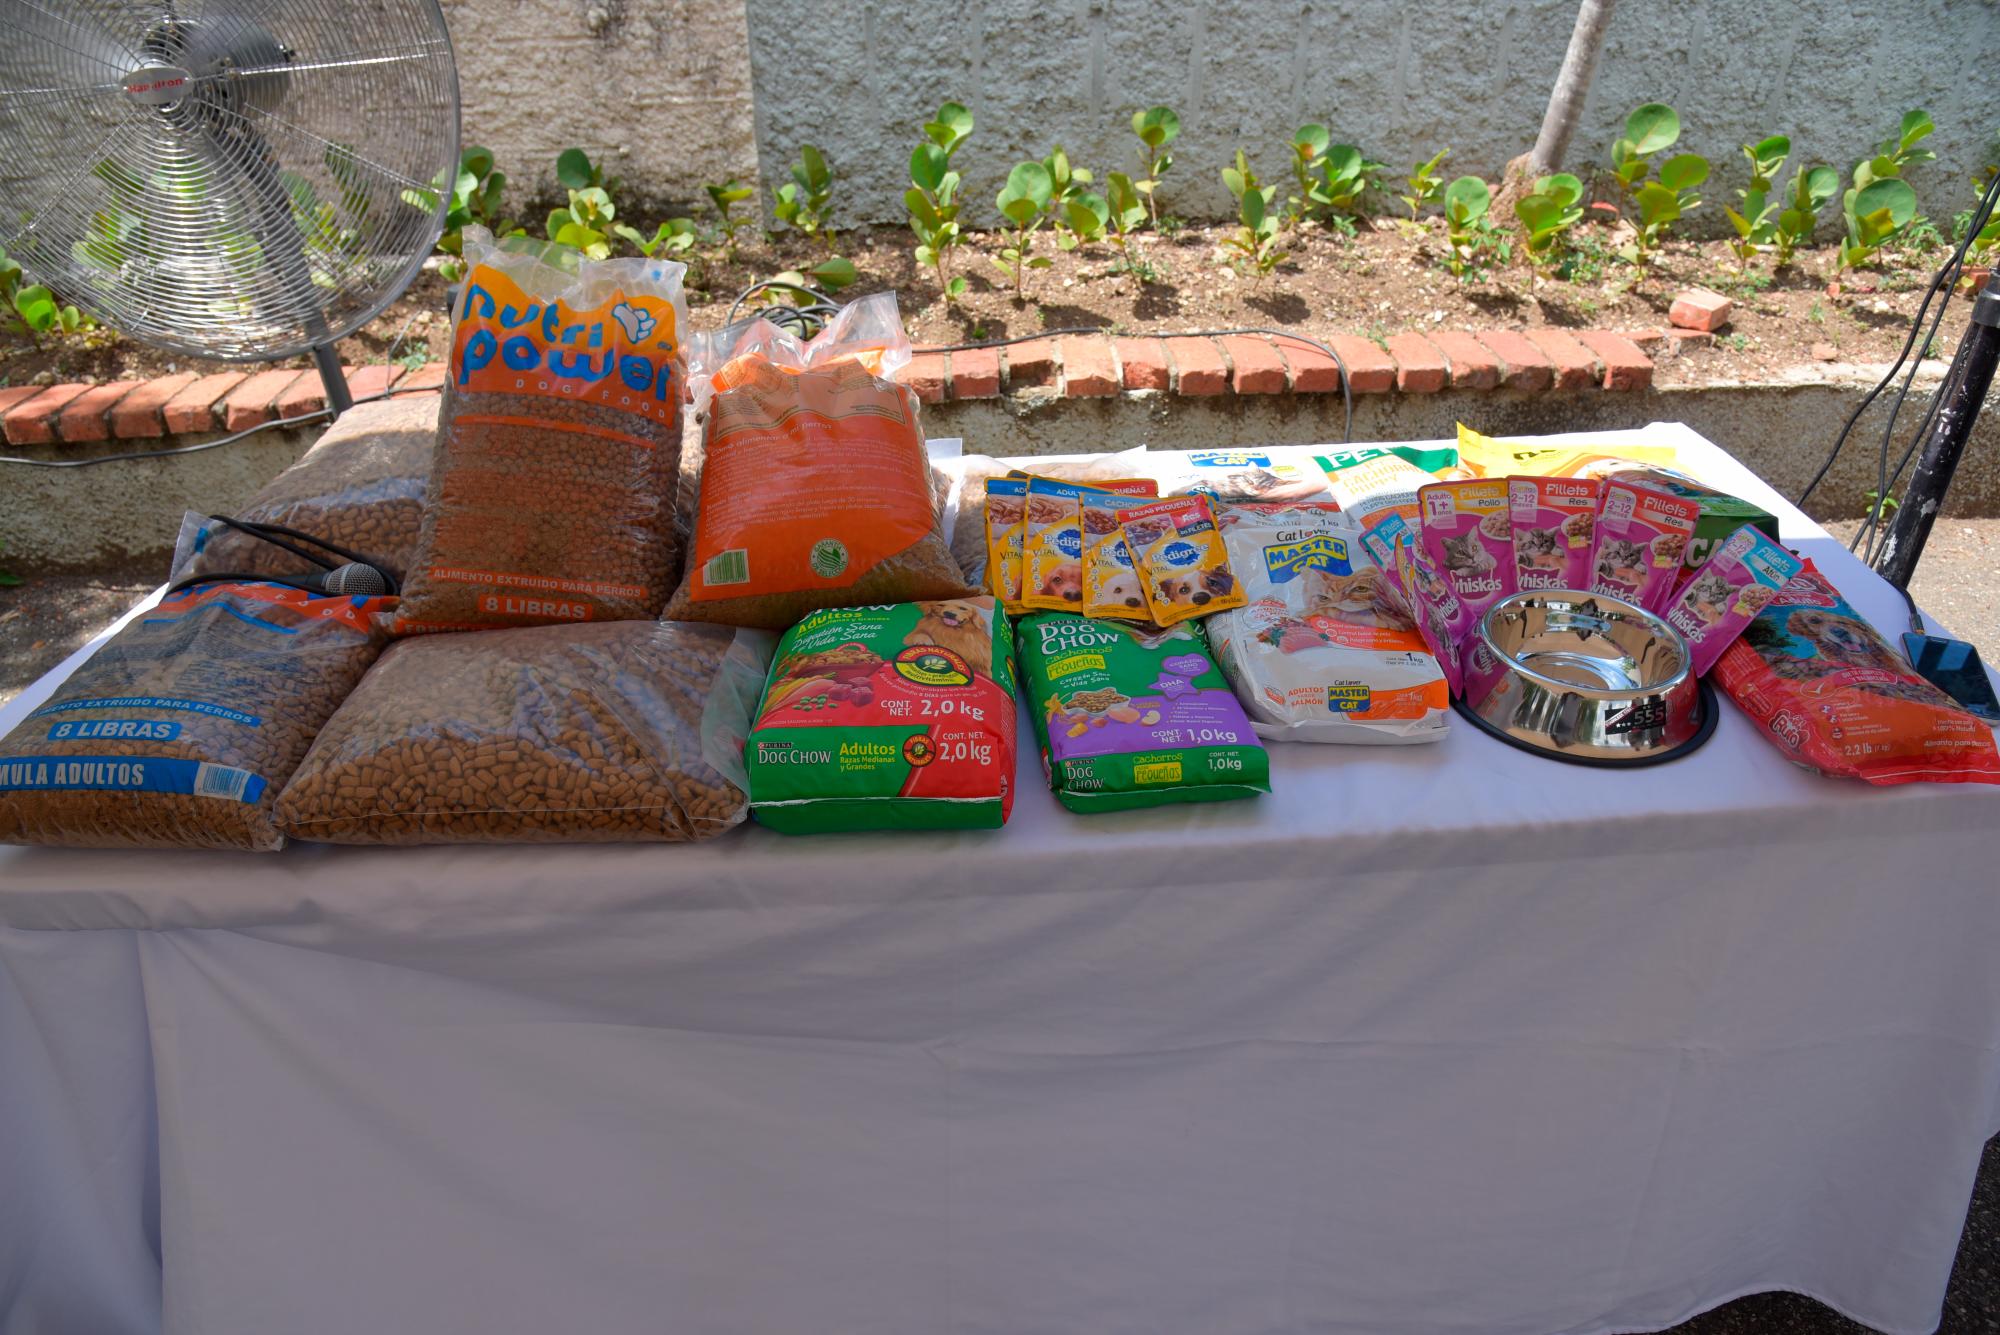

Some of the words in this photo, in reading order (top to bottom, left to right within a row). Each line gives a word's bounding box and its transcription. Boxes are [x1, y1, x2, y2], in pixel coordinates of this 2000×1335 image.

[462, 284, 603, 348] nutri
[515, 379, 573, 394] DOG
[602, 390, 665, 418] FOOD
[1056, 488, 1081, 497] ADULT
[1114, 485, 1147, 495] QUEÑAS
[1546, 483, 1589, 496] Fillets
[1427, 493, 1452, 501] Adulto
[1478, 499, 1500, 507] Pollo
[1511, 494, 1535, 503] 2-12
[1568, 498, 1589, 506] Res
[1607, 501, 1632, 514] 2-12
[1644, 496, 1688, 518] Fillets
[1664, 516, 1684, 527] Res
[1043, 534, 1081, 550] Pedig
[1276, 530, 1297, 542] Cat
[1152, 544, 1209, 564] Pedigree
[1269, 541, 1345, 565] MASTER
[1757, 546, 1791, 573] Fillets
[1292, 555, 1329, 573] CAT
[434, 567, 493, 583] ALIMENTO
[496, 574, 558, 590] EXTRUIDO
[561, 581, 593, 593] PARA
[596, 584, 641, 598] PERROS
[486, 598, 499, 612] 8
[506, 598, 586, 619] LIBRAS
[798, 611, 863, 635] Adultos
[846, 622, 884, 632] Sana
[839, 631, 880, 641] Sana
[1040, 624, 1095, 642] DOG
[1041, 633, 1119, 656] CHOW
[1159, 679, 1185, 689] DHA
[1288, 687, 1324, 697] ADULTOS
[1329, 688, 1369, 698] MASTER
[86, 698, 151, 708] EXTRUIDO
[154, 698, 190, 710] PARA
[195, 702, 253, 724] PERROS
[880, 700, 913, 709] CONT.
[920, 699, 955, 717] 2,0
[959, 700, 985, 721] kg
[1339, 700, 1359, 710] CAT
[889, 708, 913, 717] NET.
[1634, 707, 1664, 725] 555
[56, 721, 72, 738] 8
[77, 721, 171, 739] LIBRAS
[968, 731, 986, 739] NET.
[1151, 729, 1182, 738] CONT.
[1187, 729, 1212, 744] 1,0
[1214, 729, 1238, 743] kg
[1161, 736, 1184, 744] NET.
[839, 742, 896, 756] Adultos
[939, 742, 967, 763] 2,0
[970, 740, 992, 766] kg
[1863, 743, 1872, 754] lb
[758, 750, 789, 765] DOG
[790, 749, 831, 765] CHOW
[839, 756, 860, 765] Razas
[861, 756, 896, 765] Medianas
[846, 763, 875, 772] Grandes
[1207, 759, 1226, 771] 1,0
[1226, 758, 1242, 771] kg
[54, 762, 145, 786] ADULTOS
[1067, 767, 1094, 780] DOG
[1067, 778, 1104, 790] CHOW
